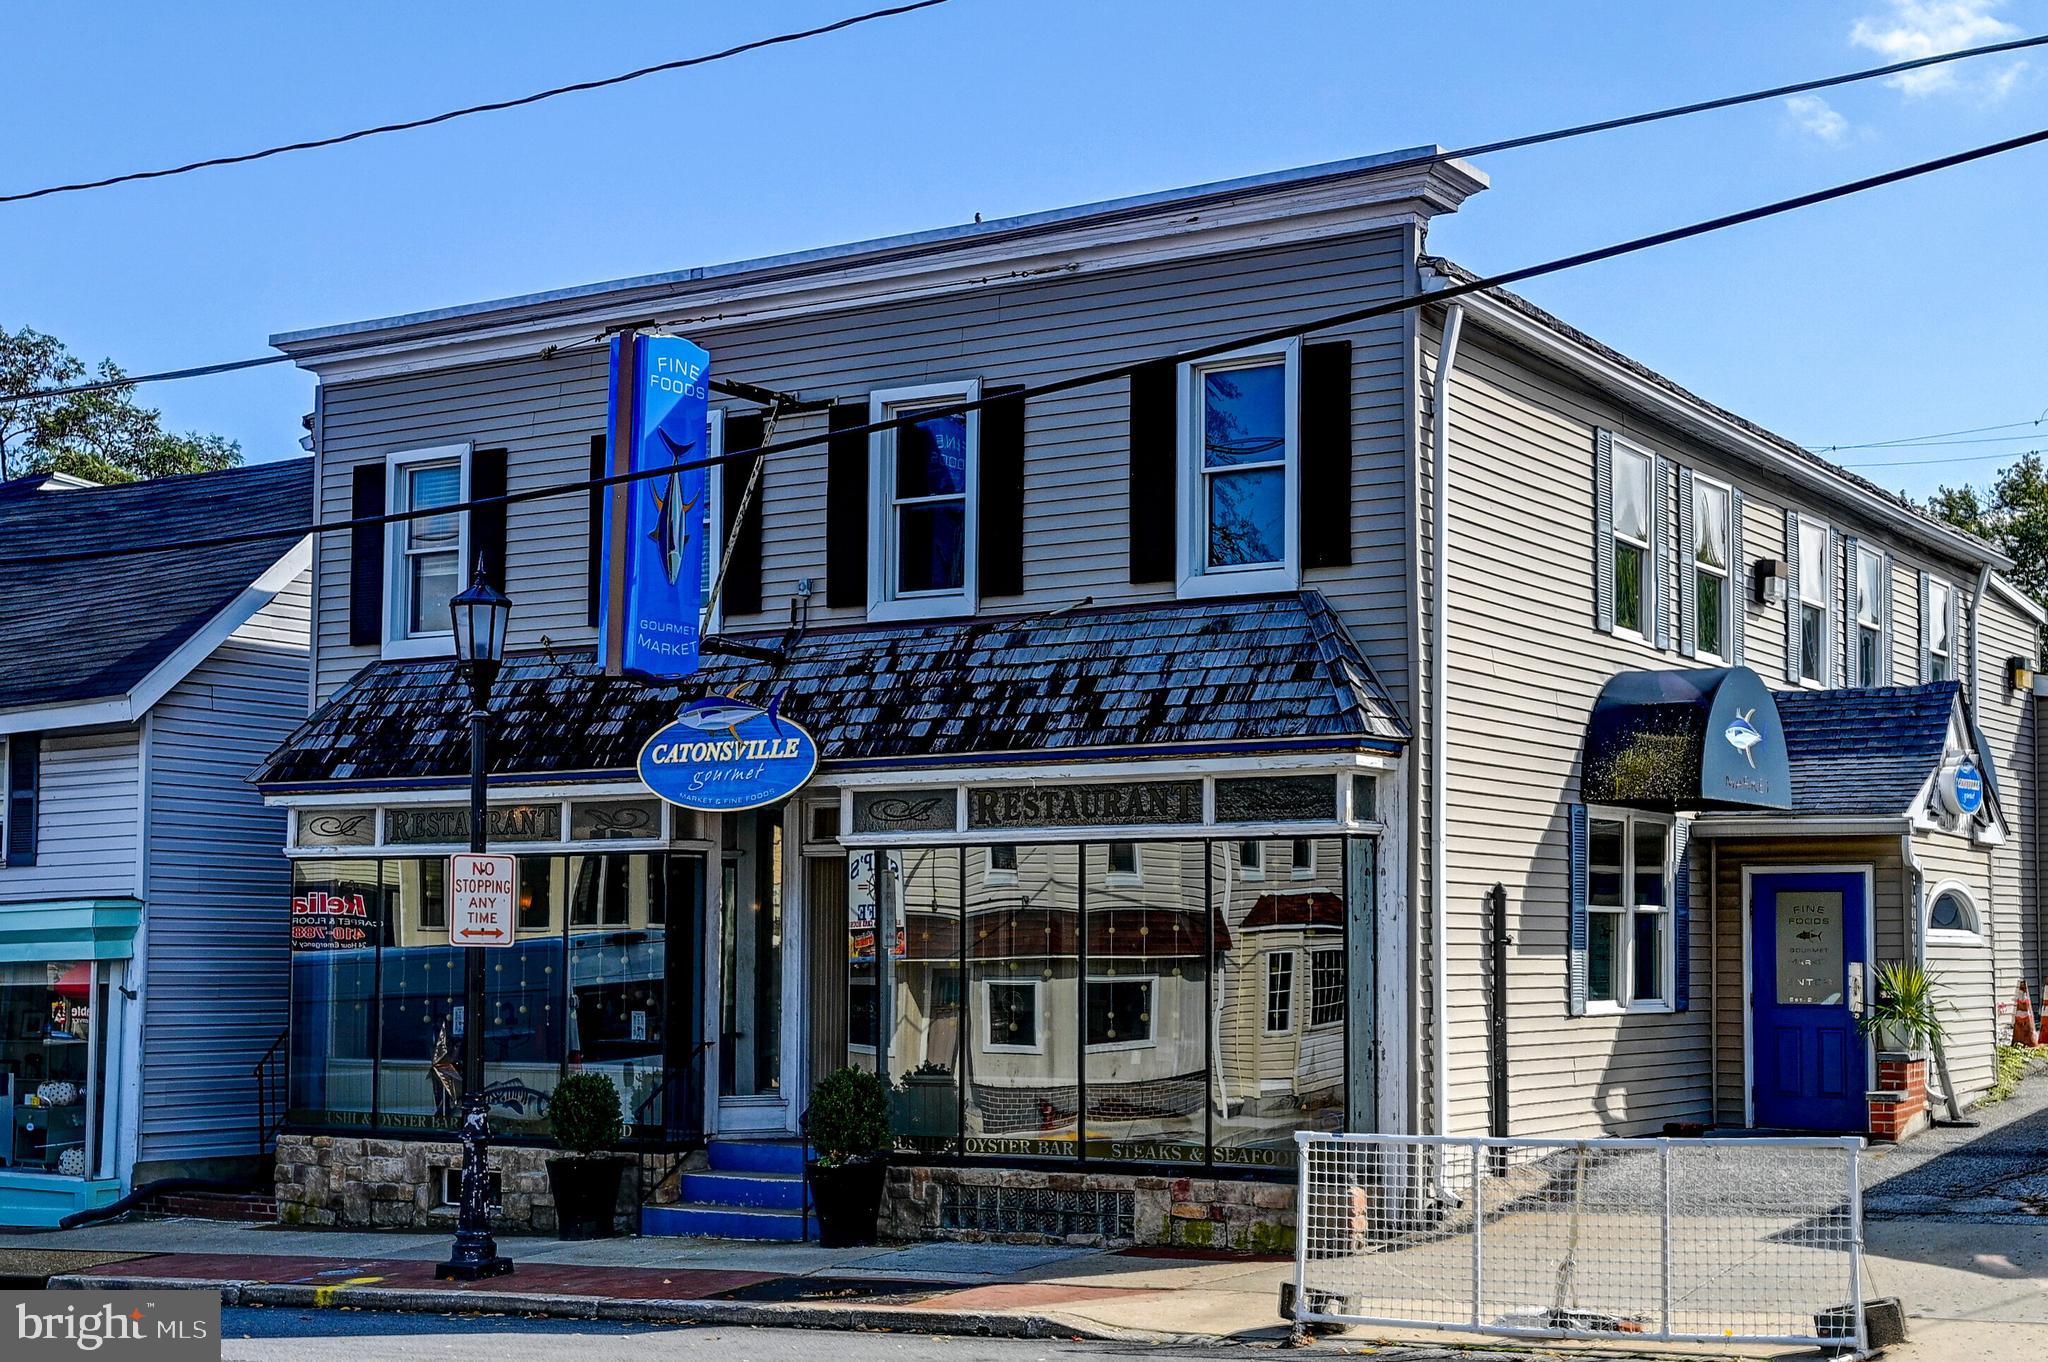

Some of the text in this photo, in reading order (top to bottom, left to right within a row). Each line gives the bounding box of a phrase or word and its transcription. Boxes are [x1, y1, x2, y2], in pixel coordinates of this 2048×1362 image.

[657, 357, 700, 381] FINE
[650, 374, 705, 399] FOODS
[640, 619, 696, 636] GOURMET
[637, 633, 697, 655] MARKET
[651, 737, 801, 765] CATONSVILLE
[687, 762, 765, 791] gourmet
[679, 792, 713, 804] MARKET
[724, 796, 743, 804] FINE
[745, 788, 776, 802] FOODS
[975, 783, 1197, 825] RESTAURANT
[391, 806, 558, 841] RESTARANT
[472, 861, 495, 876] NO
[455, 878, 511, 894] STOPPING
[468, 897, 497, 909] ANY
[1793, 905, 1825, 915] FINE
[467, 911, 498, 924] TIME
[1788, 917, 1830, 925] FOODS
[327, 1111, 356, 1124] USHI
[965, 1137, 1031, 1155] OYSTER
[1037, 1140, 1074, 1156] BAR
[1111, 1142, 1183, 1161] STEAKS
[1189, 1148, 1204, 1162] &
